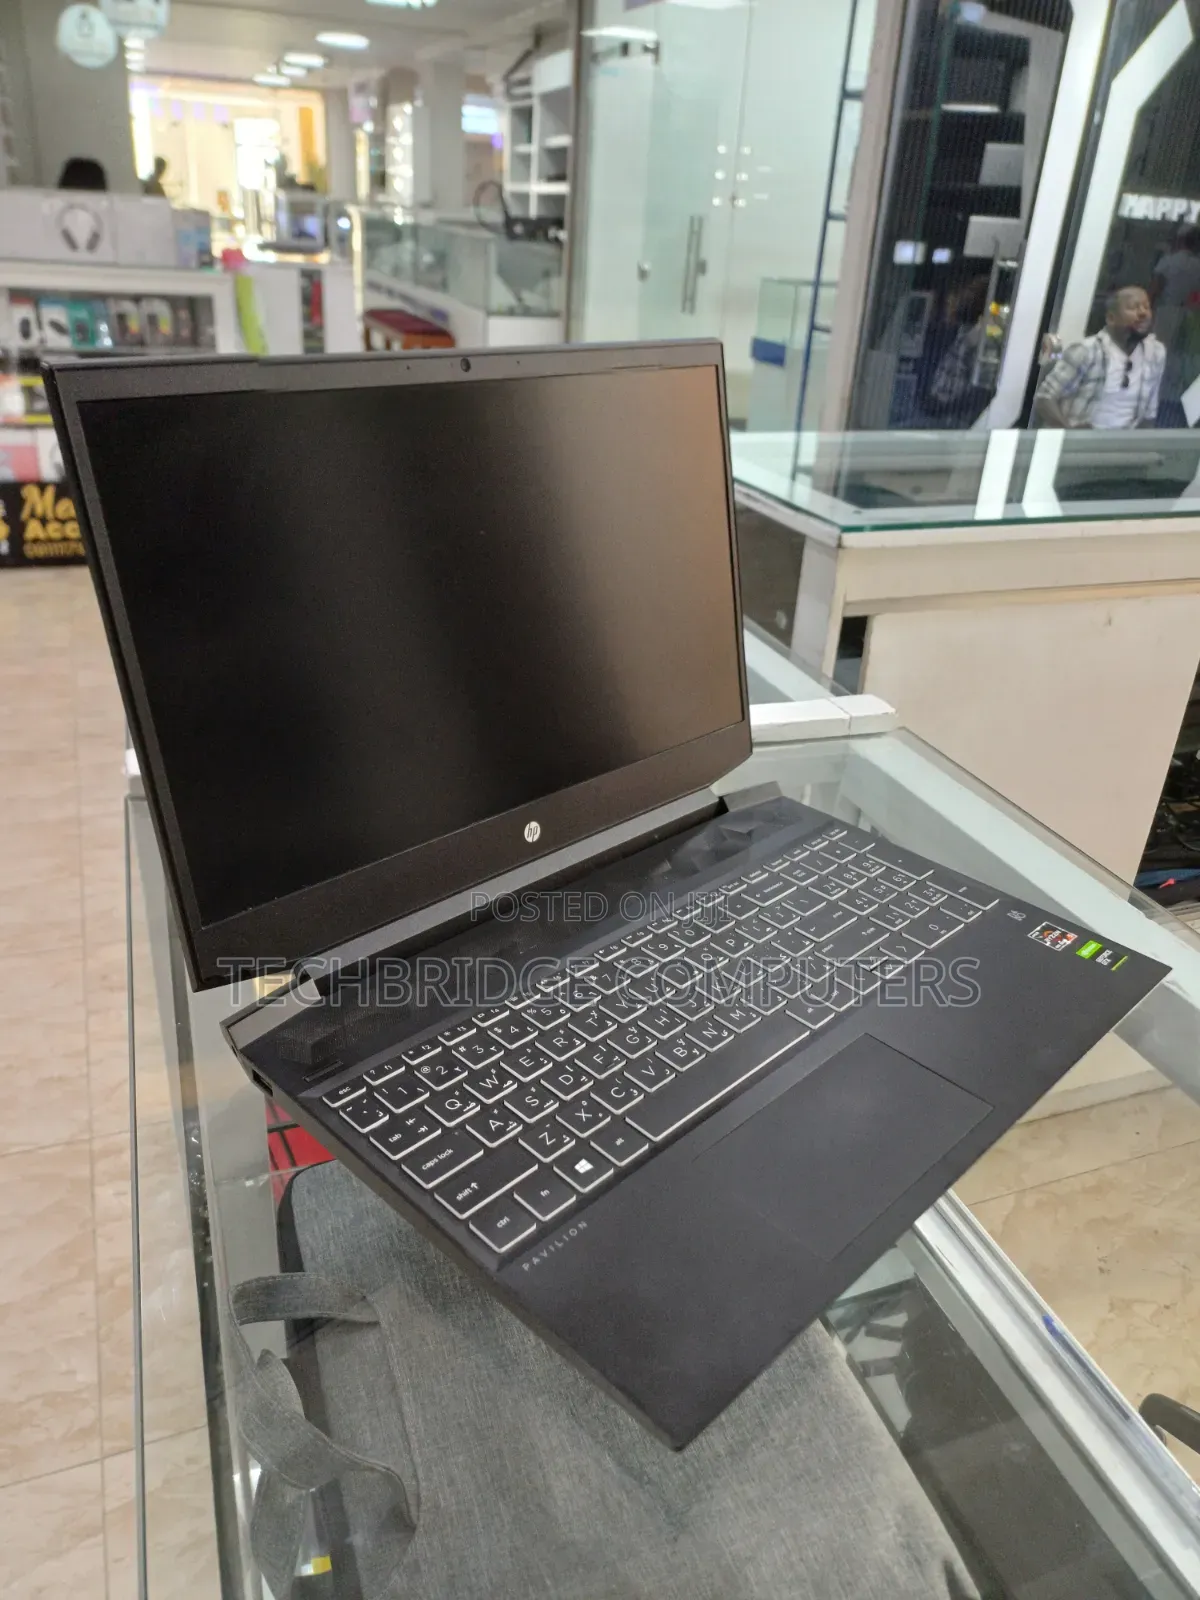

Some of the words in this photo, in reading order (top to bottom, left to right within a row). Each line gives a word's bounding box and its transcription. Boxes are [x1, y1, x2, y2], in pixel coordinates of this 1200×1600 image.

[524, 821, 541, 843] hp
[862, 861, 873, 869] 9
[843, 872, 853, 880] 8
[892, 874, 902, 882] 6
[823, 883, 834, 891] 7
[873, 886, 883, 894] 5
[923, 888, 934, 897] 3
[904, 901, 915, 910] 2
[928, 923, 939, 931] 0
[684, 929, 696, 937] 0
[658, 943, 669, 951] 9
[725, 939, 735, 948] P
[700, 953, 713, 961] O
[601, 973, 612, 982] 7
[573, 989, 584, 999] 6
[616, 999, 629, 1009] Y
[540, 1007, 552, 1016] 5
[729, 1009, 747, 1021] M
[585, 1016, 598, 1027] T
[654, 1015, 671, 1027] H
[510, 1025, 520, 1034] 4
[702, 1027, 719, 1039] N
[552, 1037, 569, 1048] R
[626, 1034, 640, 1044] G
[472, 1045, 484, 1054] 3
[672, 1046, 688, 1058] B
[519, 1055, 535, 1067] E
[592, 1053, 604, 1065] F
[436, 1065, 449, 1075] 2
[641, 1065, 656, 1076] V
[479, 1075, 499, 1089] W
[558, 1074, 574, 1086] D
[339, 1086, 351, 1095] esc
[610, 1086, 626, 1098] C
[445, 1099, 463, 1110] Q
[525, 1095, 539, 1107] S
[574, 1107, 593, 1122] X
[489, 1119, 505, 1132] A
[388, 1133, 402, 1143] tab
[538, 1131, 557, 1145] Z
[421, 1157, 439, 1171] caps
[437, 1148, 454, 1160] lock
[456, 1187, 473, 1201] shift
[540, 1188, 550, 1198] fn
[496, 1216, 511, 1229] ctrl
[521, 1220, 589, 1272] PAVILION
